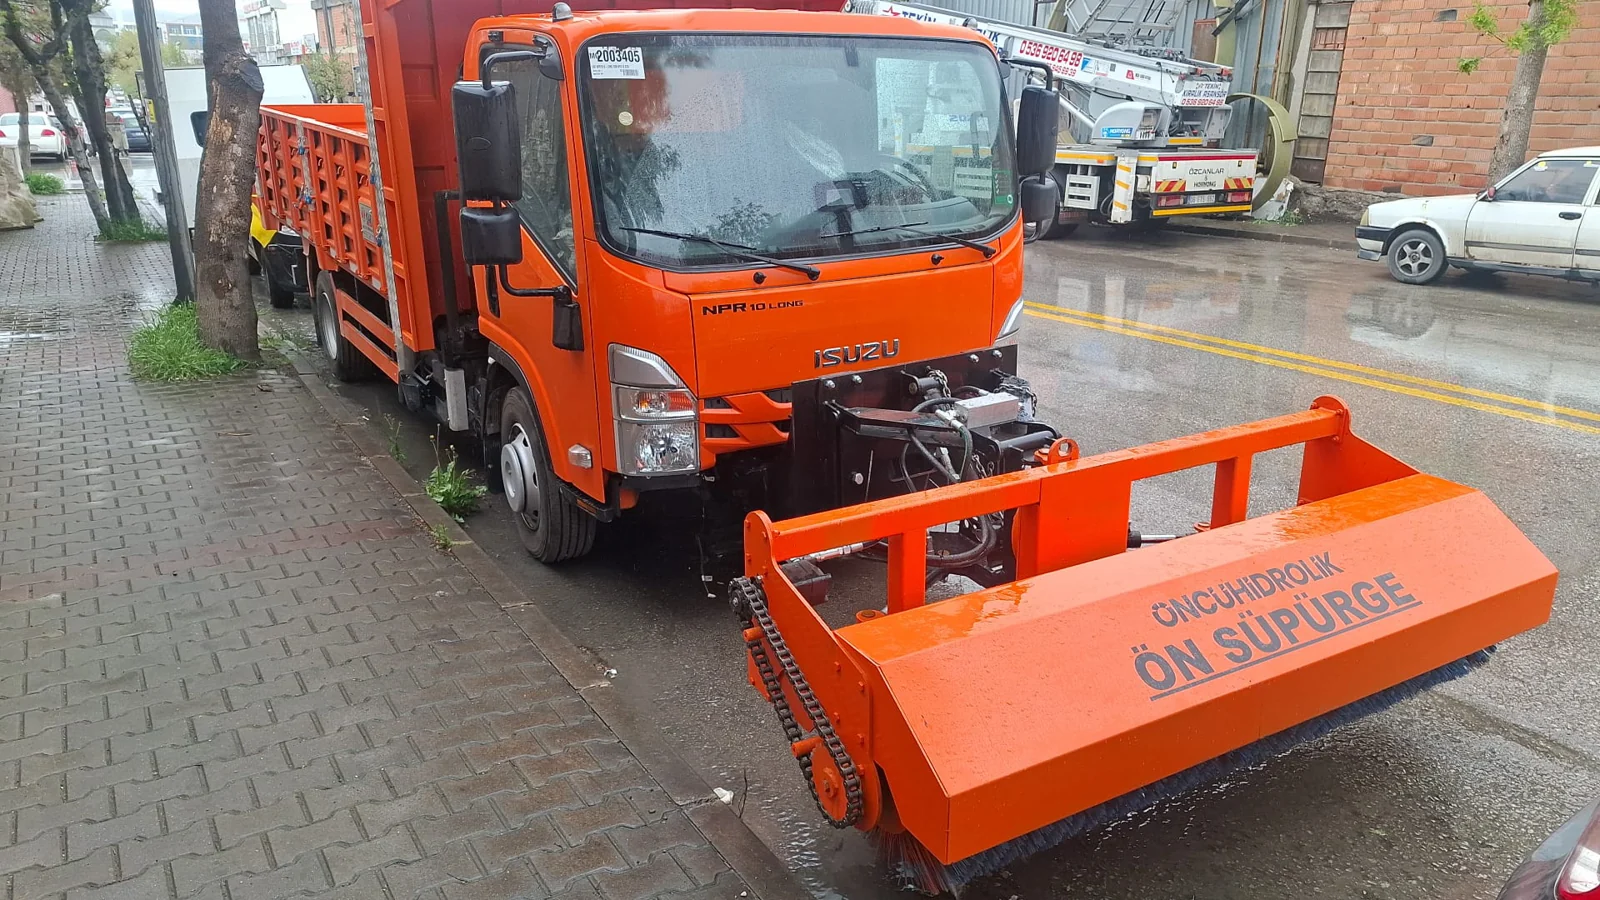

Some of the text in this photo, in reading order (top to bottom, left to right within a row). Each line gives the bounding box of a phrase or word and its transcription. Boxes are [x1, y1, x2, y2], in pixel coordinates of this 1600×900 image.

[1041, 45, 1060, 62] 920
[1057, 48, 1071, 65] 64
[1069, 51, 1083, 68] 98
[702, 299, 804, 316] NPR 10 LONG
[814, 338, 900, 369] ISUZU
[1130, 571, 1417, 692] ÖN SÜPÜRGE
